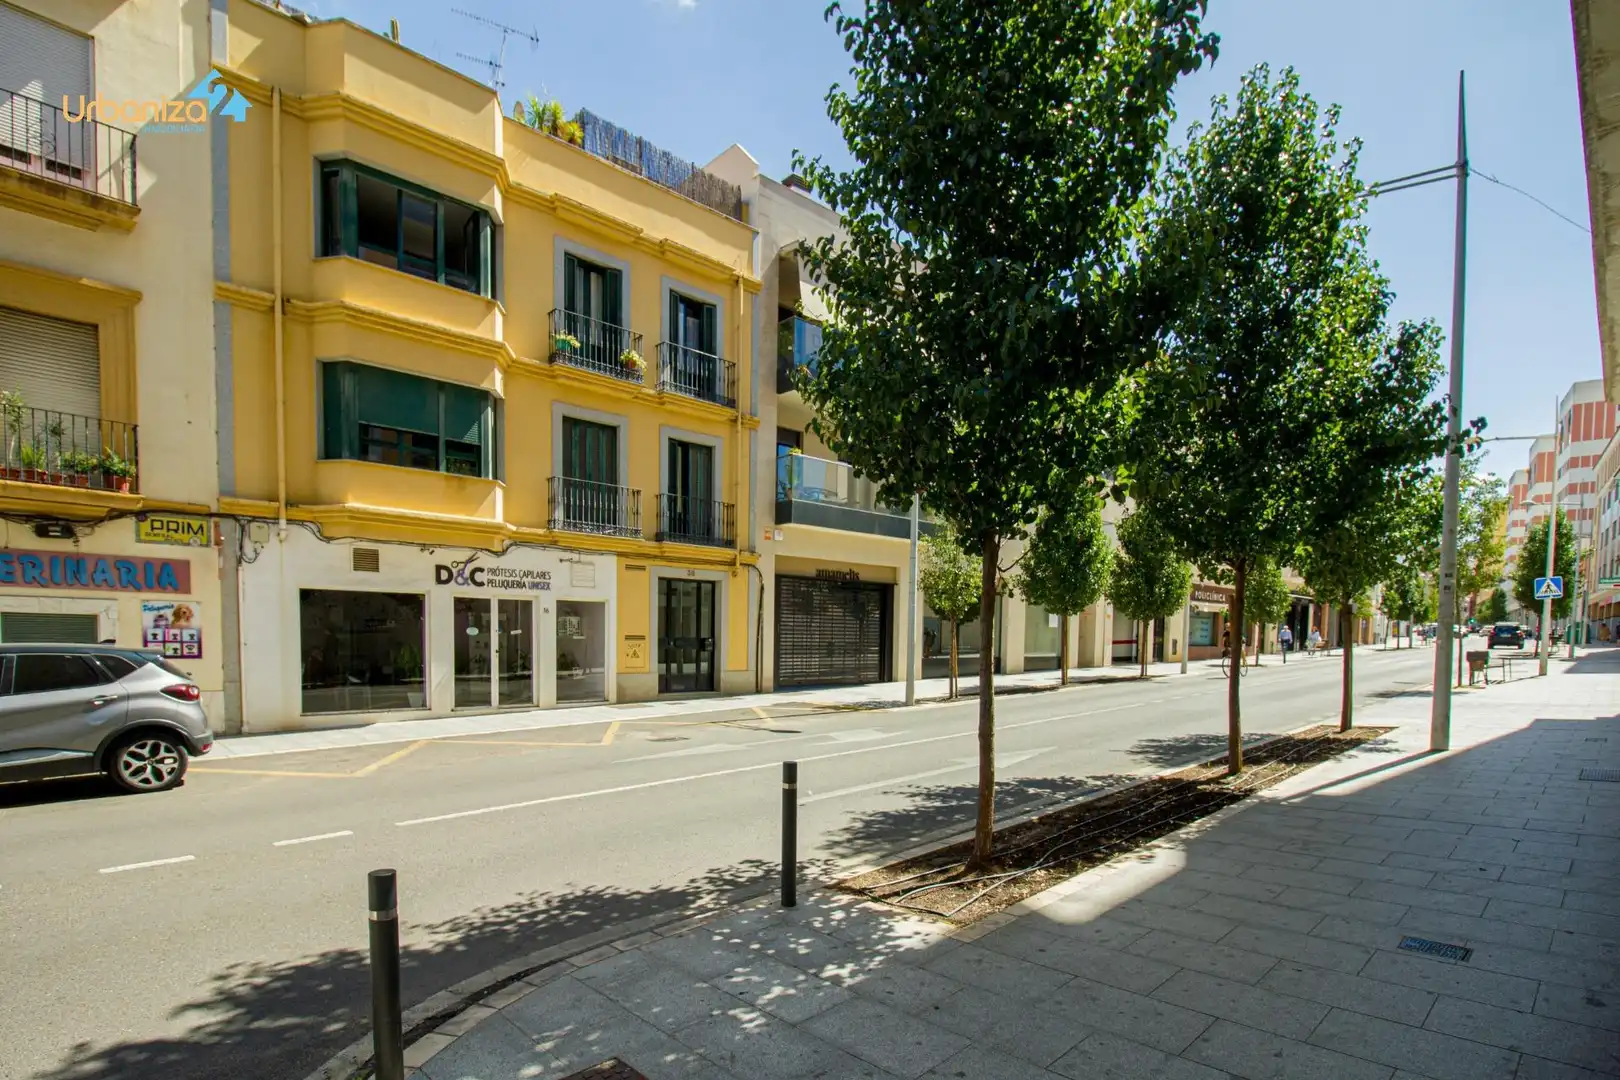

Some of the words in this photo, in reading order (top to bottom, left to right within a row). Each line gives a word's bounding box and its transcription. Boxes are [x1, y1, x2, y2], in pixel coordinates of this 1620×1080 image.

[150, 519, 205, 536] PRIM
[487, 566, 517, 578] PRÓTESIS
[487, 578, 526, 589] PELUQUERÍA
[528, 581, 551, 591] UNISEX
